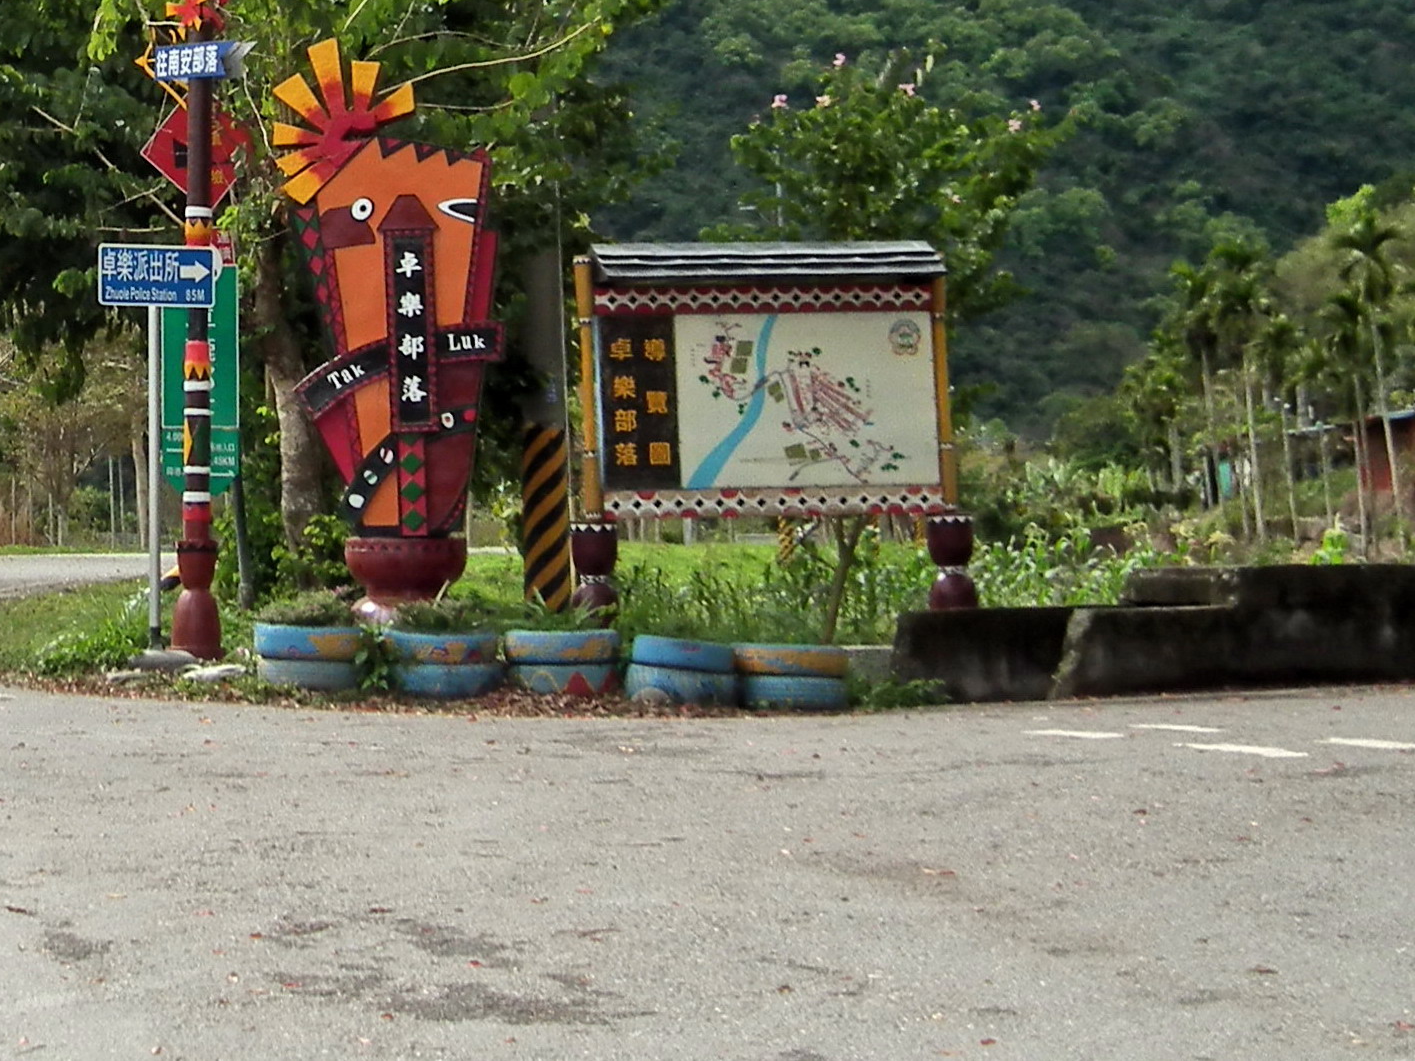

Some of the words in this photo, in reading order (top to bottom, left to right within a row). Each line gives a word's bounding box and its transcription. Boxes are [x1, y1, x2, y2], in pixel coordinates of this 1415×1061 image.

[156, 45, 219, 77] 往南安部落
[102, 248, 180, 284] 卓樂派出所
[130, 286, 150, 300] Police
[151, 287, 177, 301] Station
[396, 251, 427, 403] 卓樂部落
[447, 333, 486, 352] Luk
[327, 363, 366, 390] Tak
[609, 338, 638, 466] 卓樂部落
